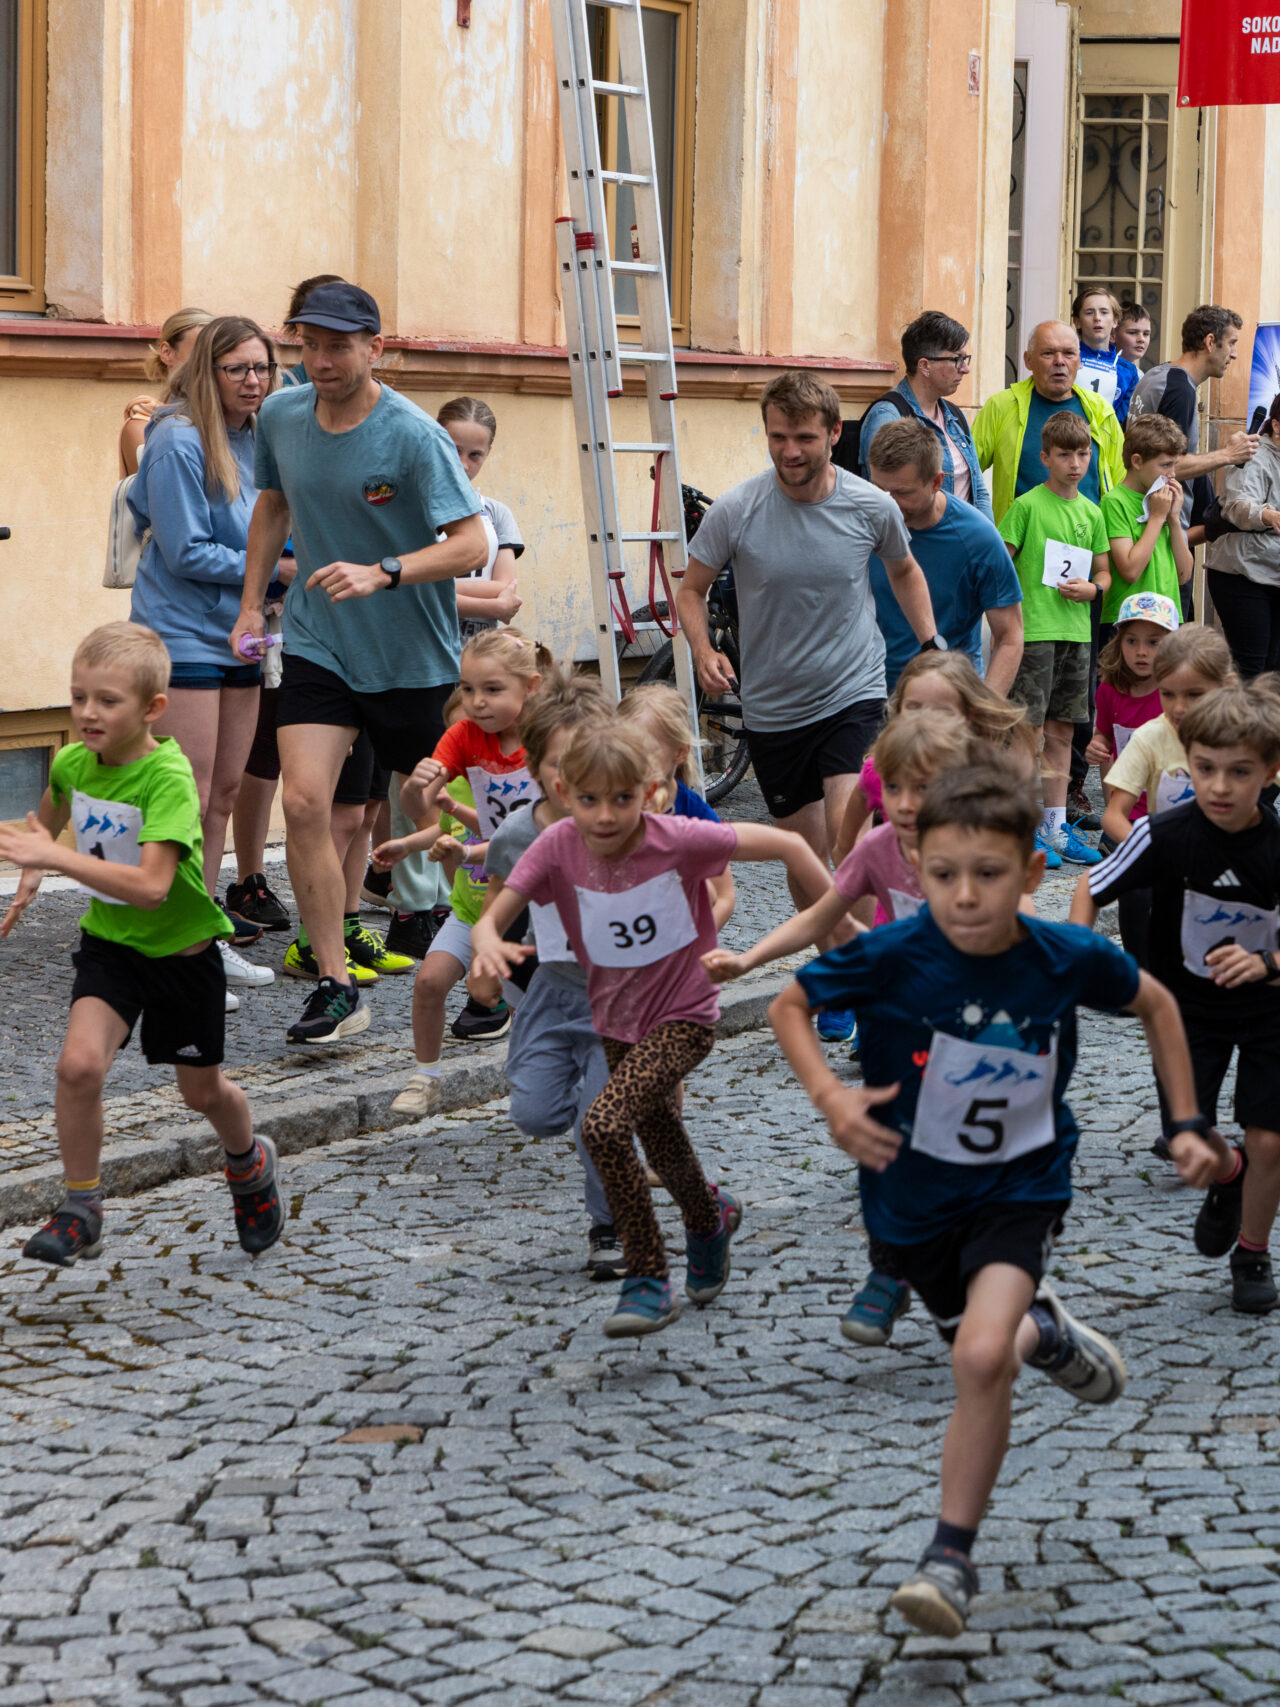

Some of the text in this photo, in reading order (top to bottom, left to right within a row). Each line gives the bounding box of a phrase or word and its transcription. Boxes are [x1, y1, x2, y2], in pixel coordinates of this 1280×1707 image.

[1060, 560, 1072, 579] 2
[608, 914, 657, 949] 39
[956, 1097, 1010, 1155] 5
